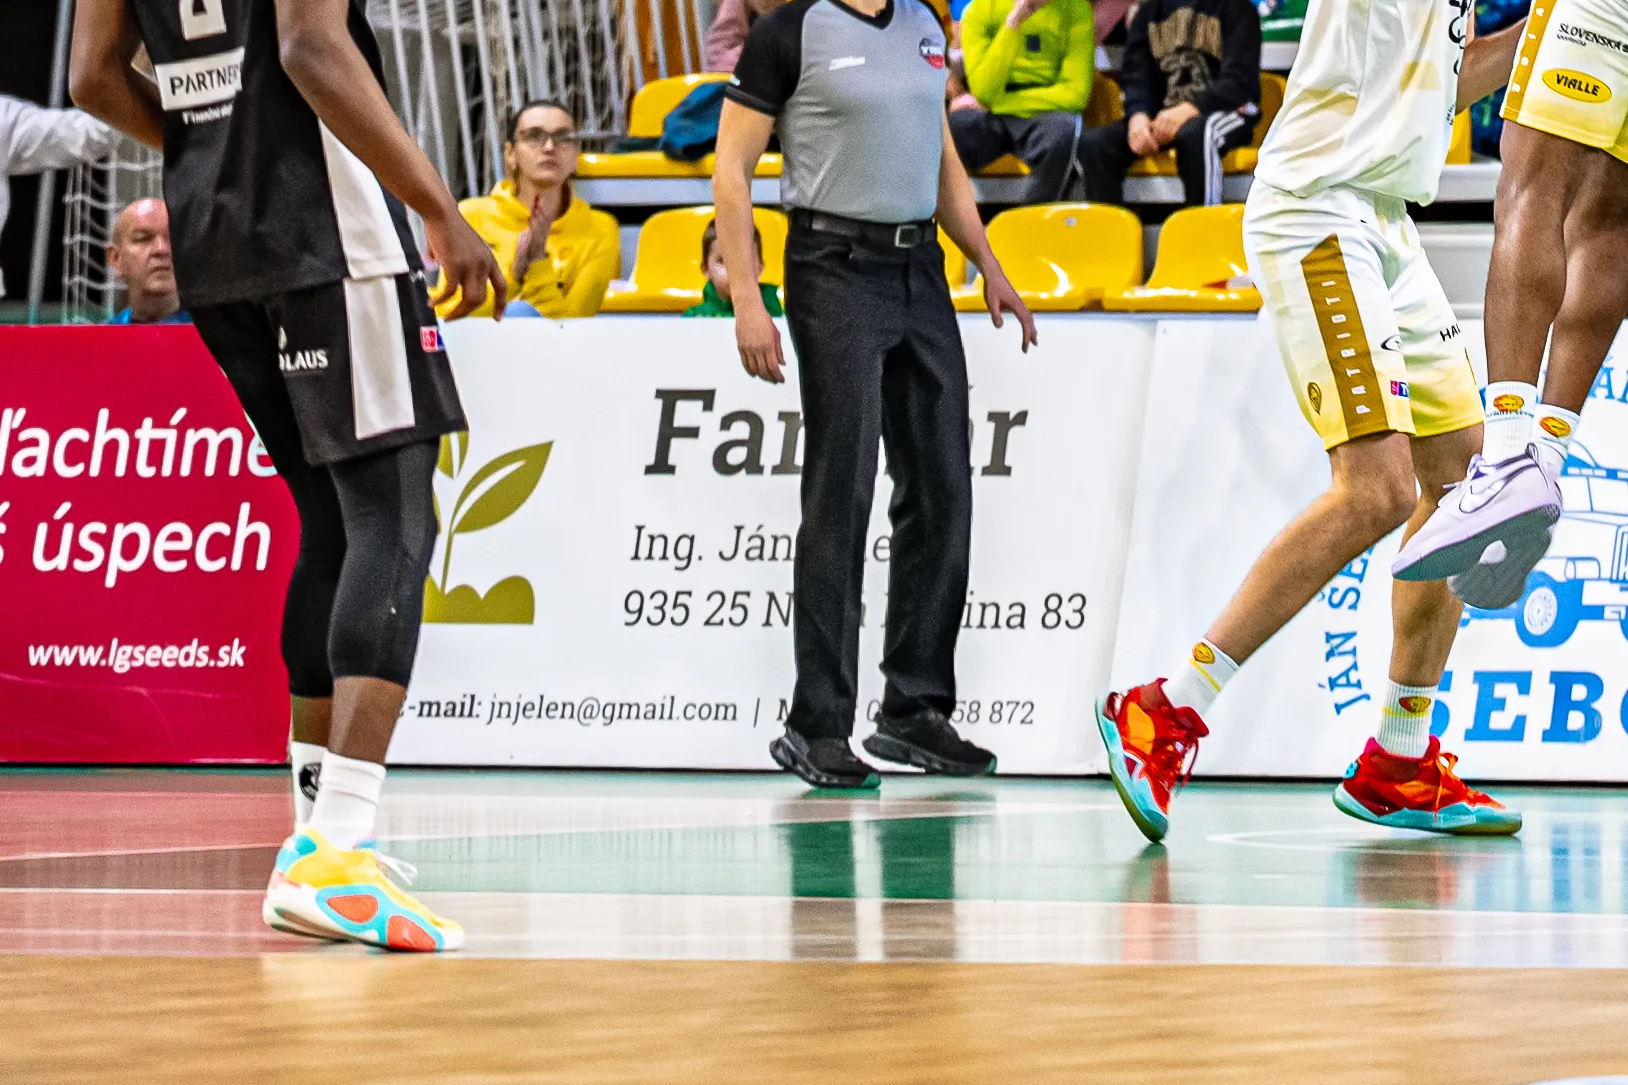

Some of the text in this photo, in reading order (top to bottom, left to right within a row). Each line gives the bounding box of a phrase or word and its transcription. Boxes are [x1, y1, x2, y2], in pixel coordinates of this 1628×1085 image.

[1555, 72, 1600, 97] VIALLE
[32, 501, 271, 588] úspech
[630, 523, 796, 571] Ing. Ján
[623, 589, 692, 627] 935
[703, 589, 751, 627] 25
[1041, 592, 1088, 630] 83
[28, 637, 246, 674] www.lgseeds.sk
[1318, 630, 1371, 716] JÁN
[401, 694, 481, 719] -mail:
[487, 694, 738, 727] jnjelen@gmail.com
[989, 700, 1035, 725] 872
